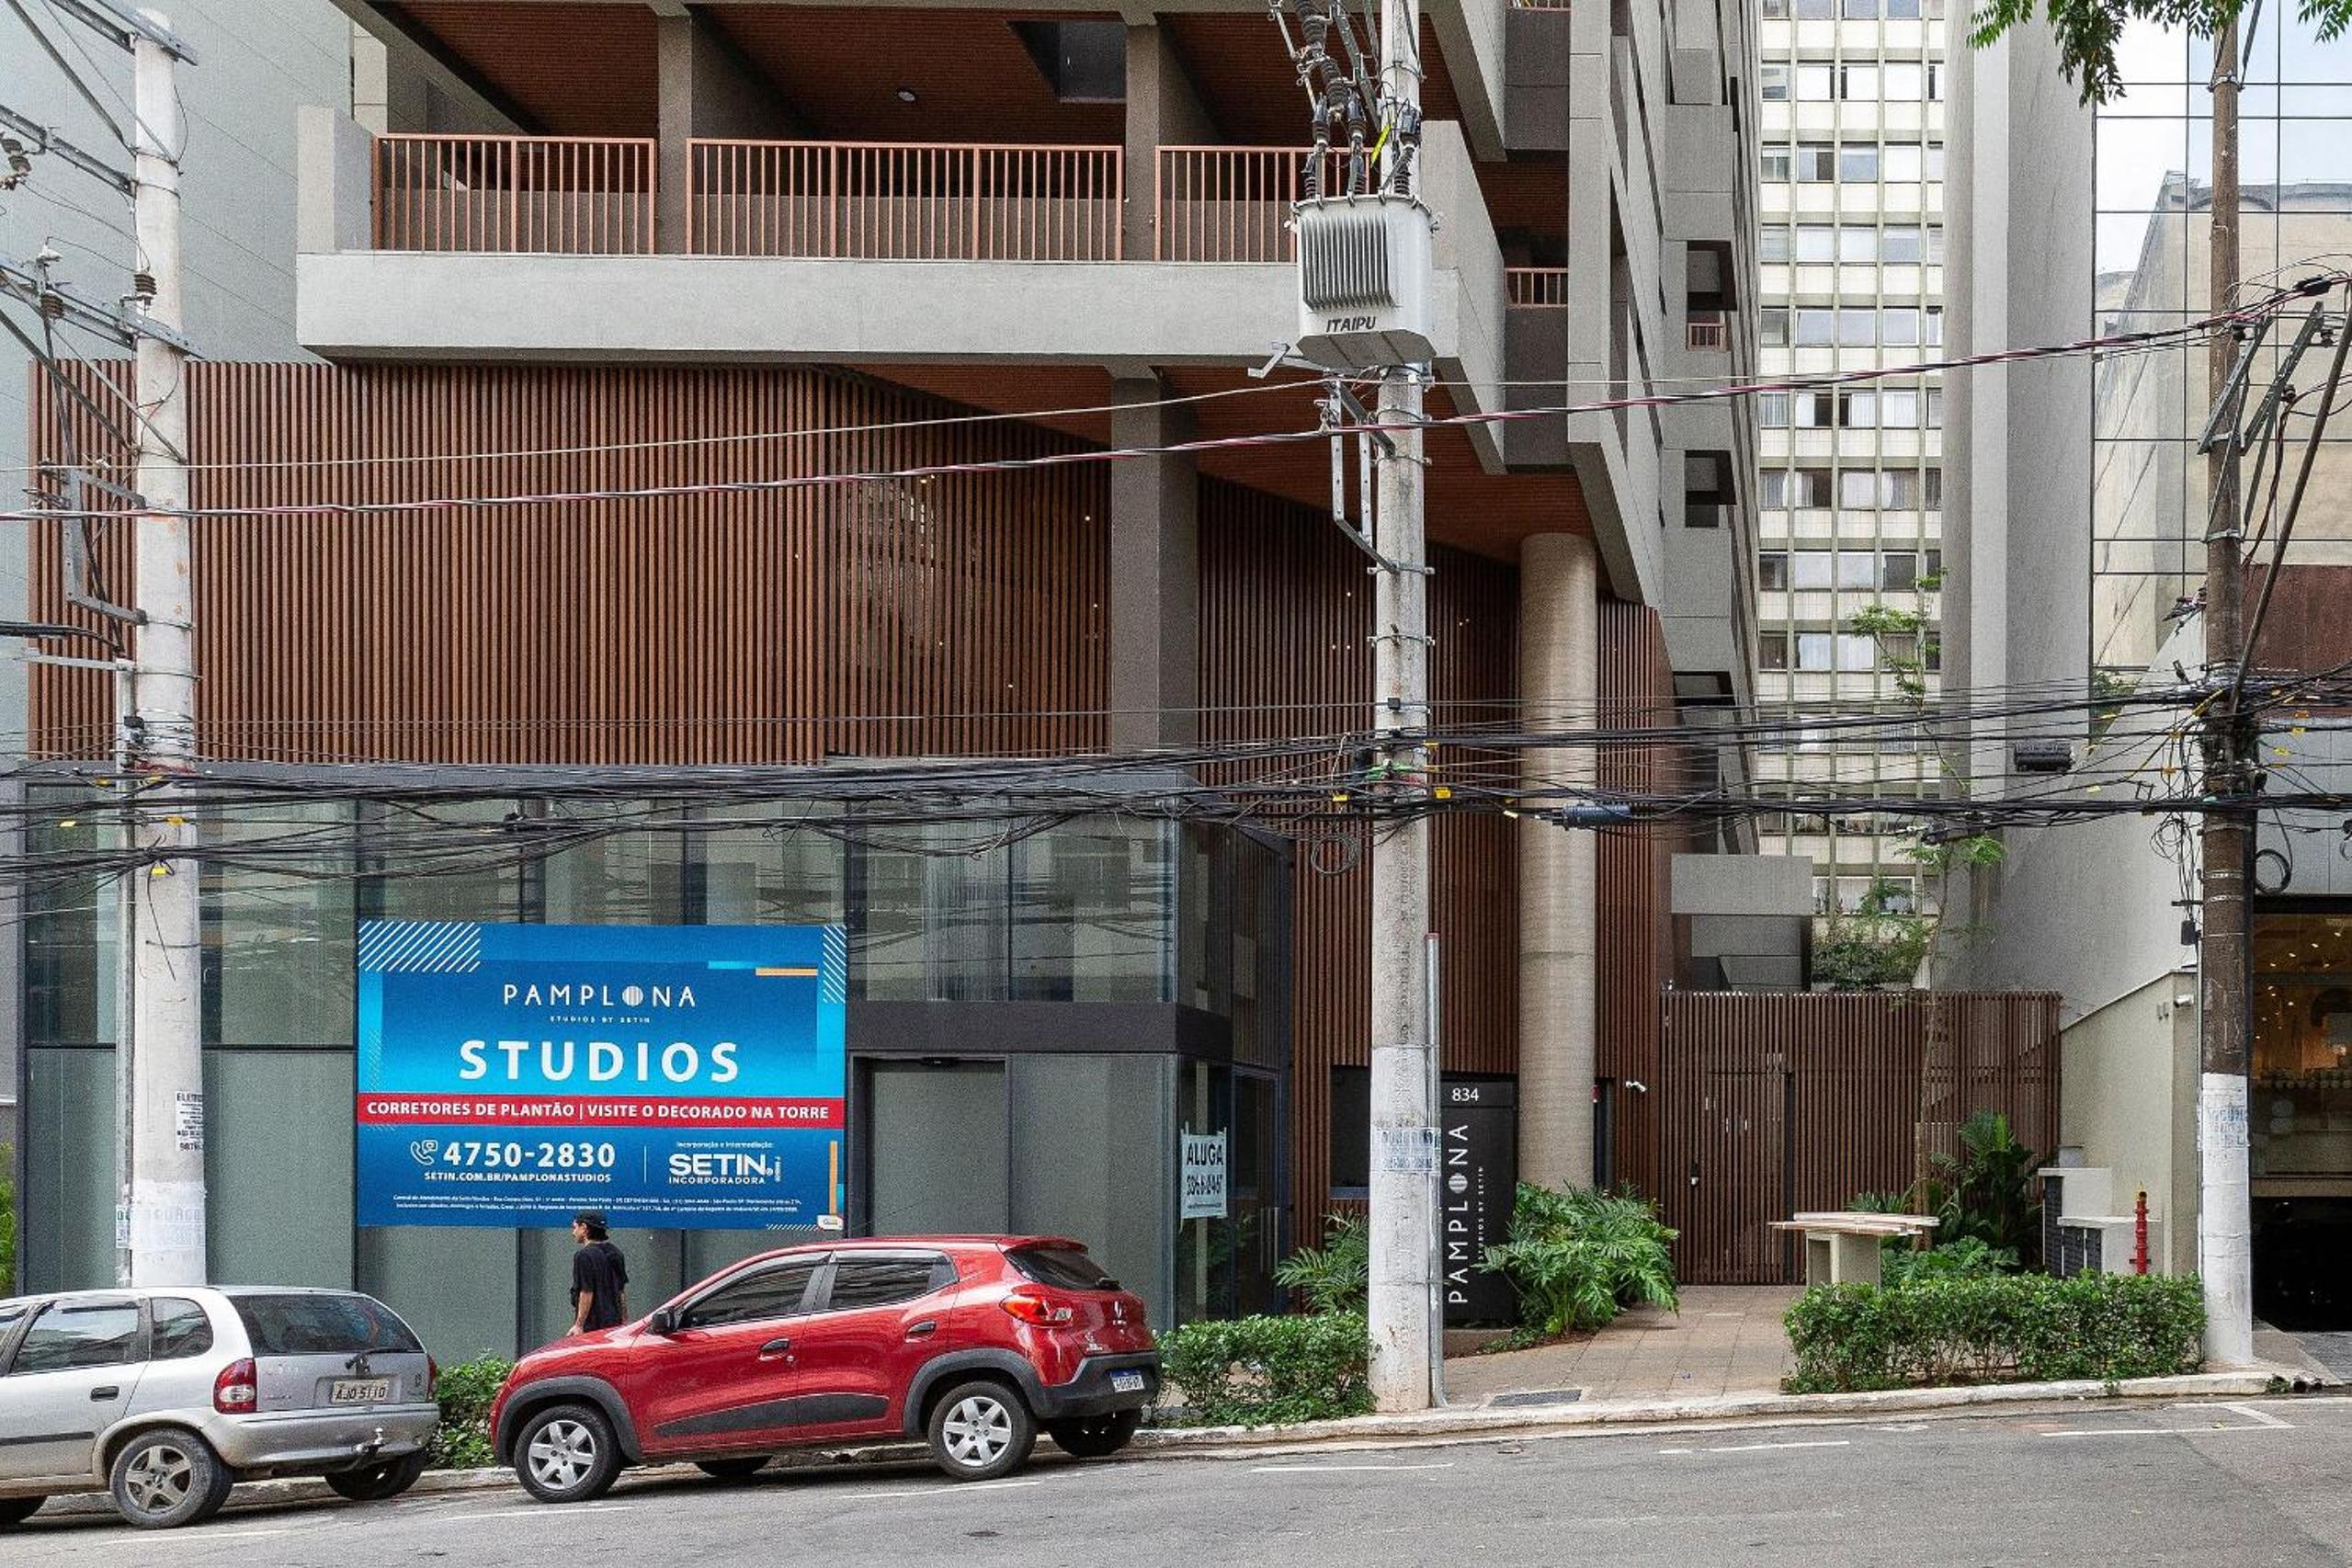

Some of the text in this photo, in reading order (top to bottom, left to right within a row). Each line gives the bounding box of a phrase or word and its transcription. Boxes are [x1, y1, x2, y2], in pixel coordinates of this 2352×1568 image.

[1326, 316, 1377, 333] ITAIPU
[504, 984, 696, 1007] PAMPLONA
[551, 1015, 596, 1023] STUDIOS
[460, 1040, 738, 1083] STUDIOS
[1451, 1087, 1480, 1101] 834
[367, 1101, 829, 1119] CORRETORES DE PLANTÃO VISITE O DECORADO NA TORRE
[443, 1142, 616, 1167] 4750-2830
[1187, 1142, 1223, 1165] ALUGA
[668, 1153, 766, 1176] SETIN
[425, 1171, 612, 1184] SETIN.COM.BR/PAMPLONASTUDIOS
[668, 1176, 766, 1185] INCORPORADORA
[1448, 1124, 1469, 1303] PAMPLONA
